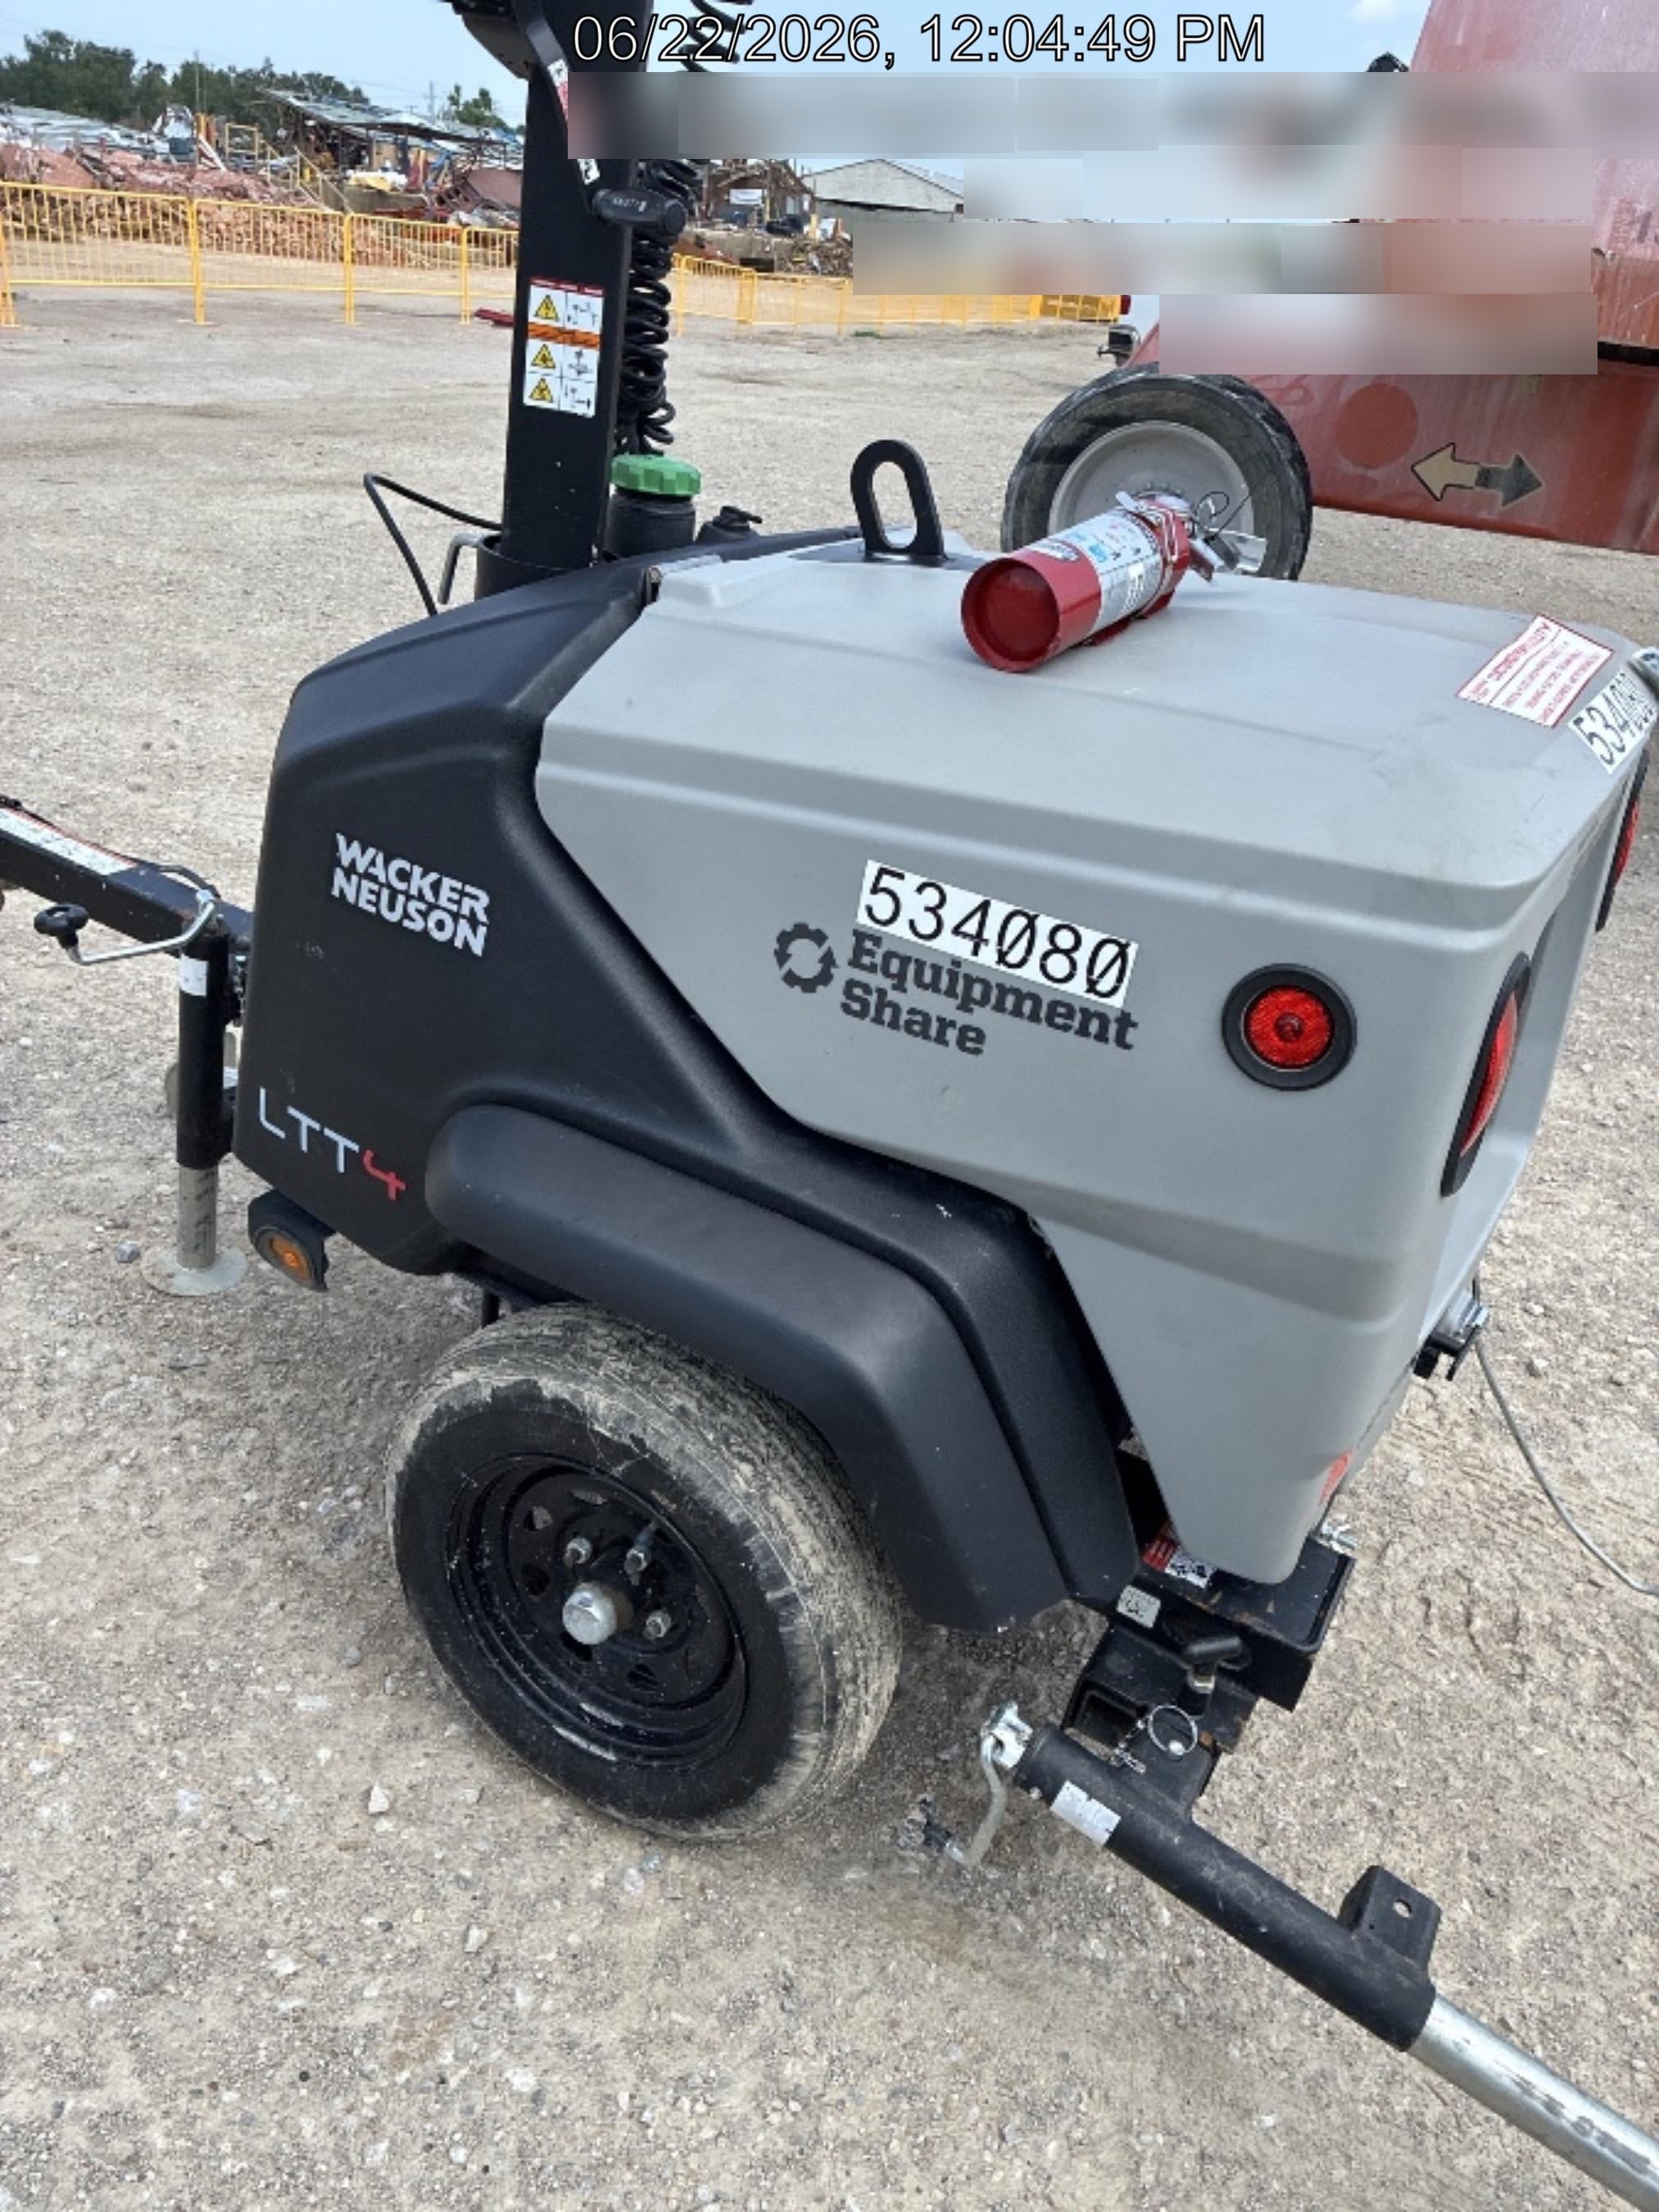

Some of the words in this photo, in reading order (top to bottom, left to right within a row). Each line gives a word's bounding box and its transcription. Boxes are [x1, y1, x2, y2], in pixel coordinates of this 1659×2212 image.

[1573, 670, 1655, 766] 5340
[331, 868, 488, 957] NEUSON
[336, 832, 490, 924] WACKER
[840, 979, 986, 1057] Share
[848, 928, 1139, 1050] Equipment
[259, 1086, 406, 1201] LTT4
